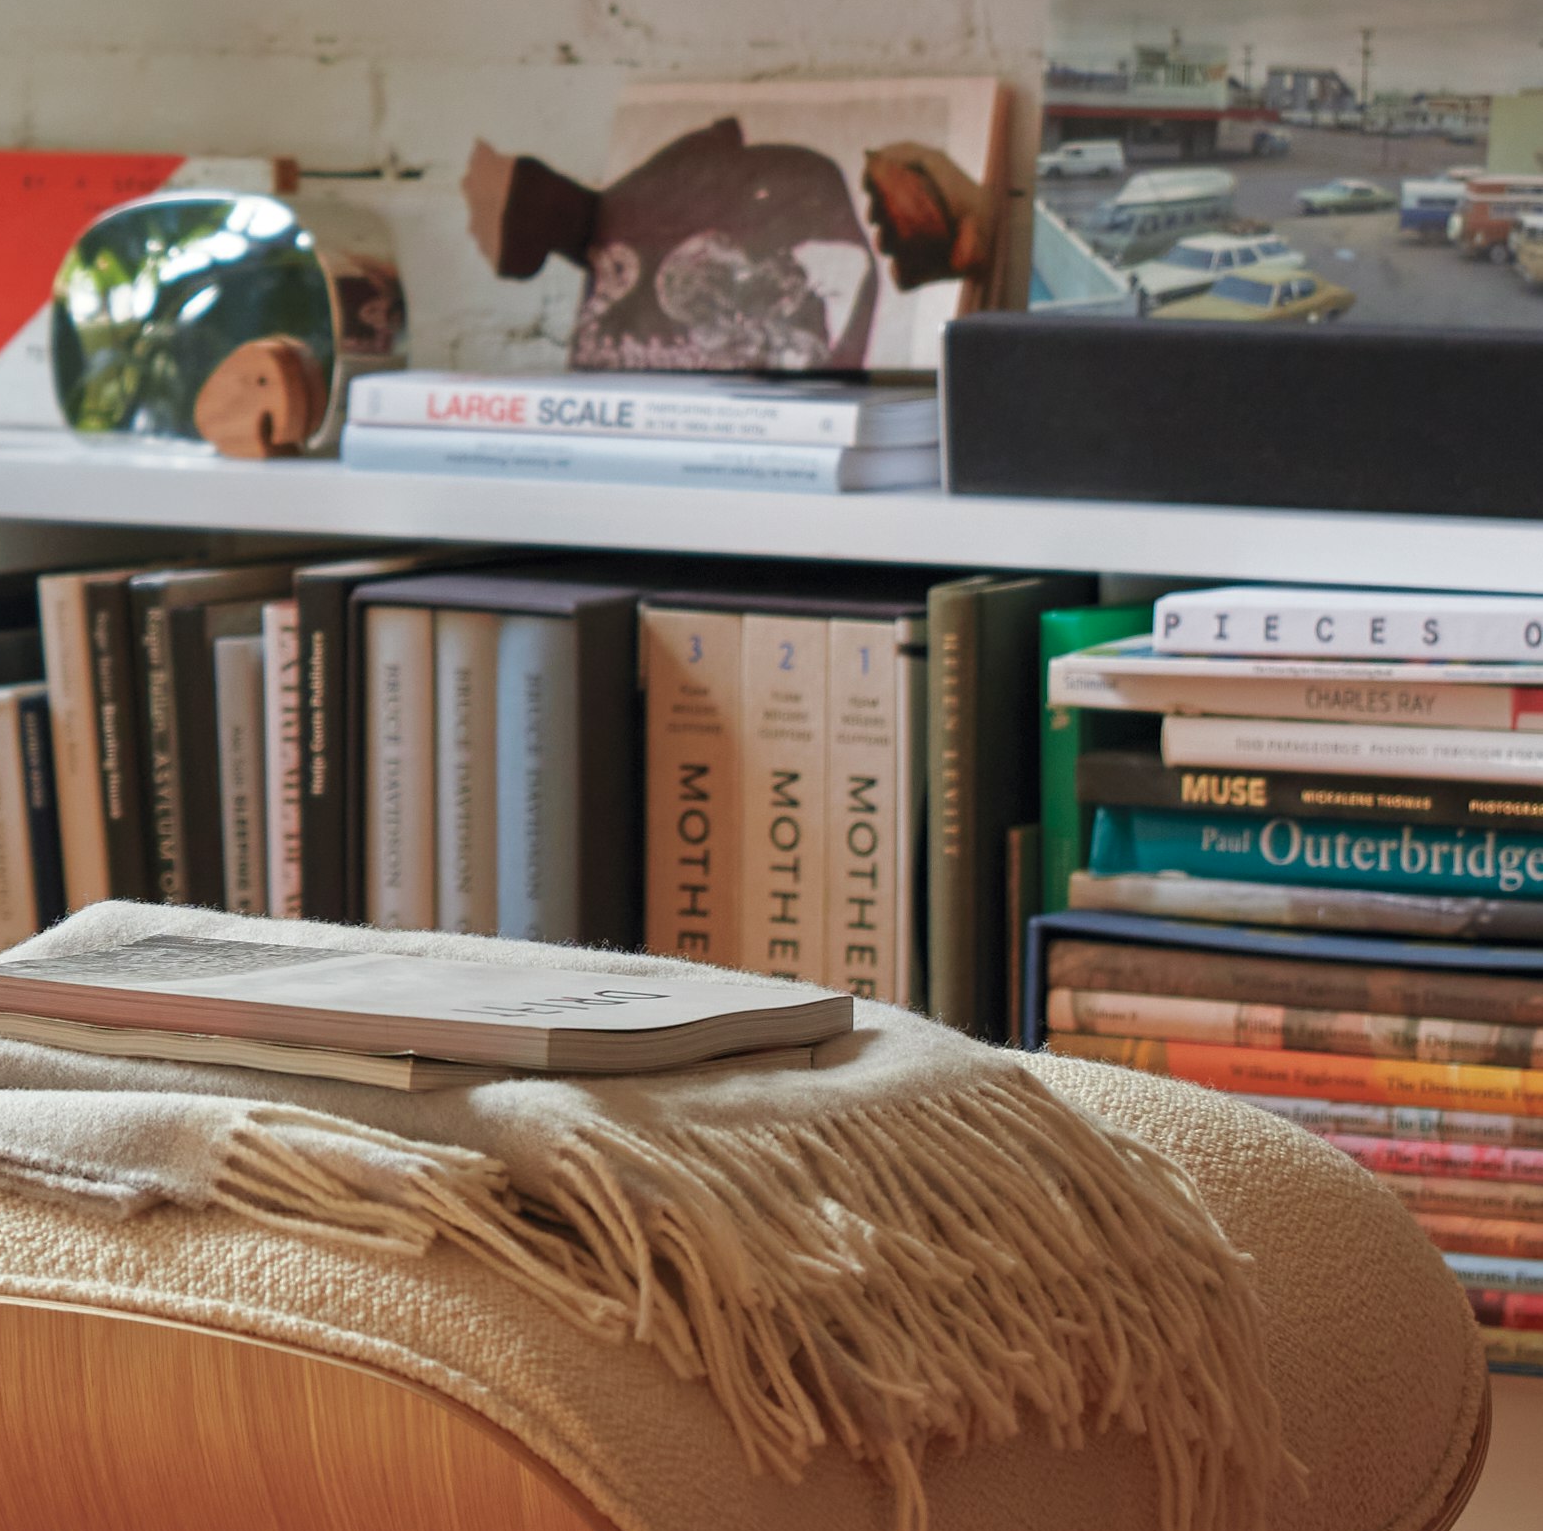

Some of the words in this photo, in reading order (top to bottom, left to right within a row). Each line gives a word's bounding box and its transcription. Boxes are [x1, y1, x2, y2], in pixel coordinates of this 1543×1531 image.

[426, 391, 527, 424] LARGE
[536, 396, 635, 428] SCALE
[1163, 612, 1441, 646] PIECES
[1523, 619, 1543, 649] O
[687, 635, 703, 664] 3
[777, 642, 795, 671] 2
[857, 645, 870, 675] 1
[1304, 688, 1390, 715] CHARLES
[1397, 691, 1438, 716] RAY
[1181, 773, 1268, 808] MUSE
[676, 763, 711, 954] MOTHE
[1200, 826, 1252, 855] Paul
[1259, 817, 1543, 892] Outerbridge
